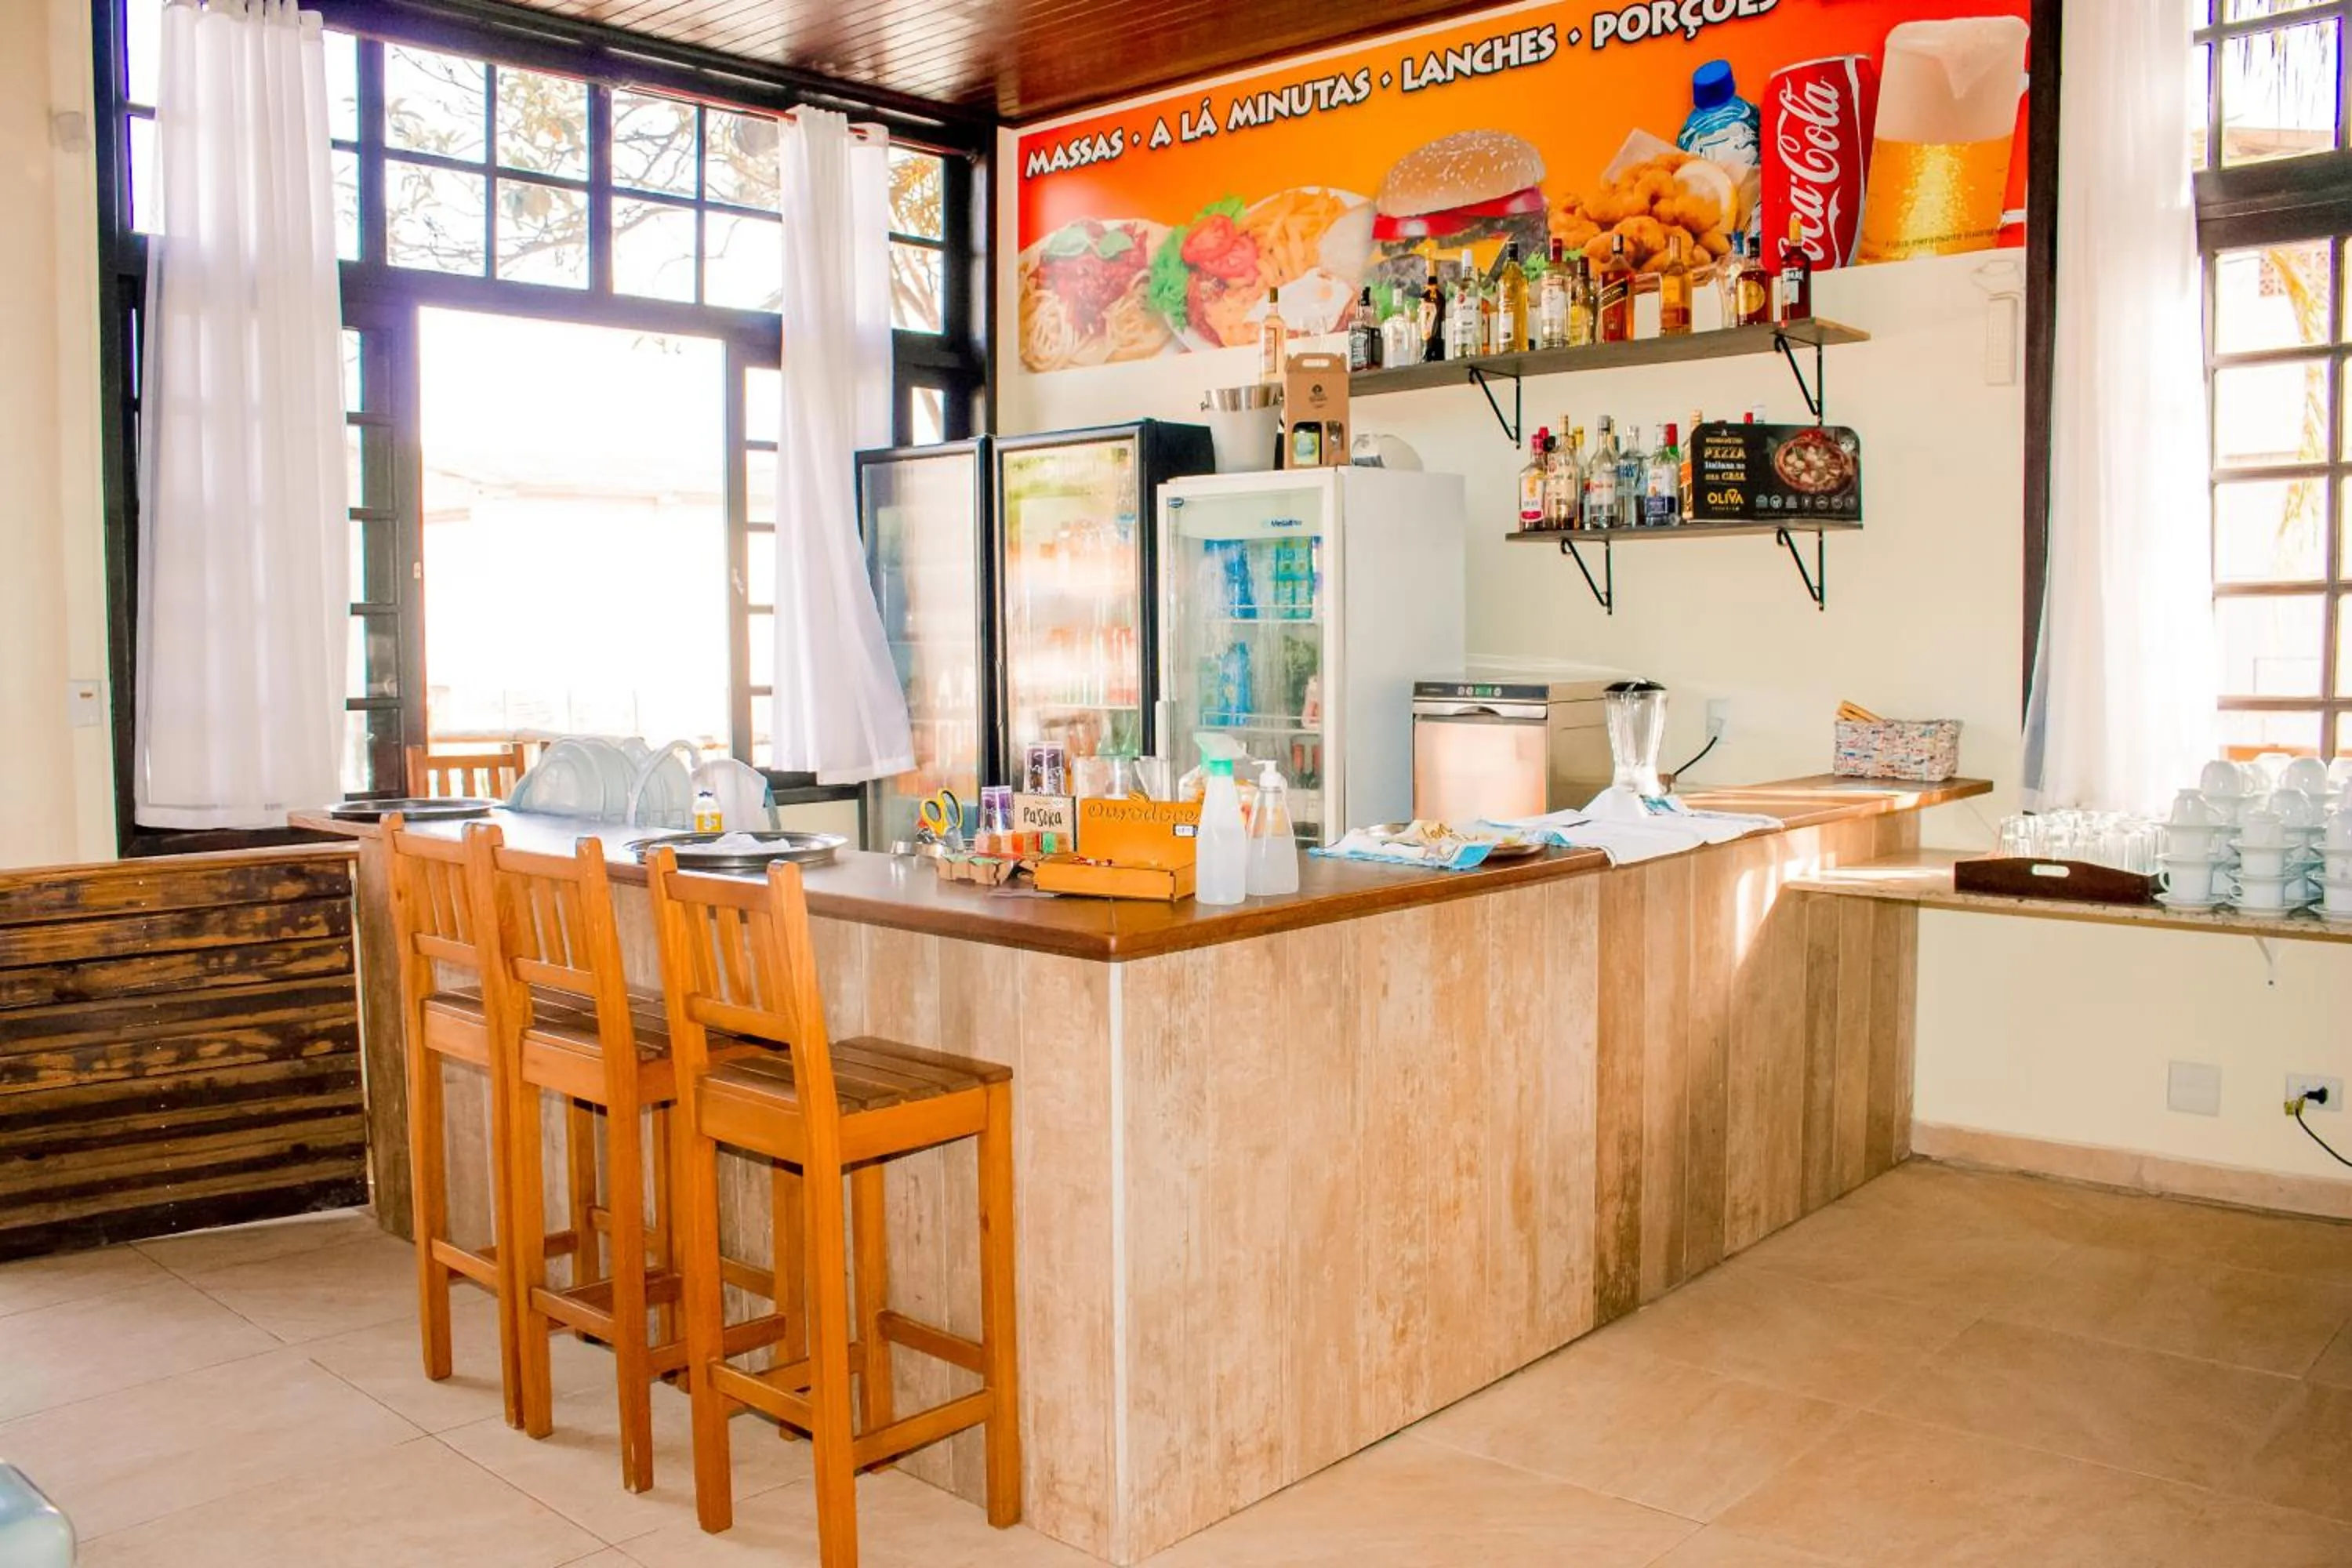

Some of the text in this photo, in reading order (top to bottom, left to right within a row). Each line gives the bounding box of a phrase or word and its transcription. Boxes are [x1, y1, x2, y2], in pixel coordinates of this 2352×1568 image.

[1025, 127, 1123, 179] MASSAS
[1149, 117, 1173, 150] A
[1180, 97, 1218, 143] LÁ
[1227, 67, 1371, 132] MINUTAS
[1402, 23, 1558, 93] LANCHES
[1704, 446, 1747, 459] PIZZA
[1707, 491, 1744, 505] OLIVA
